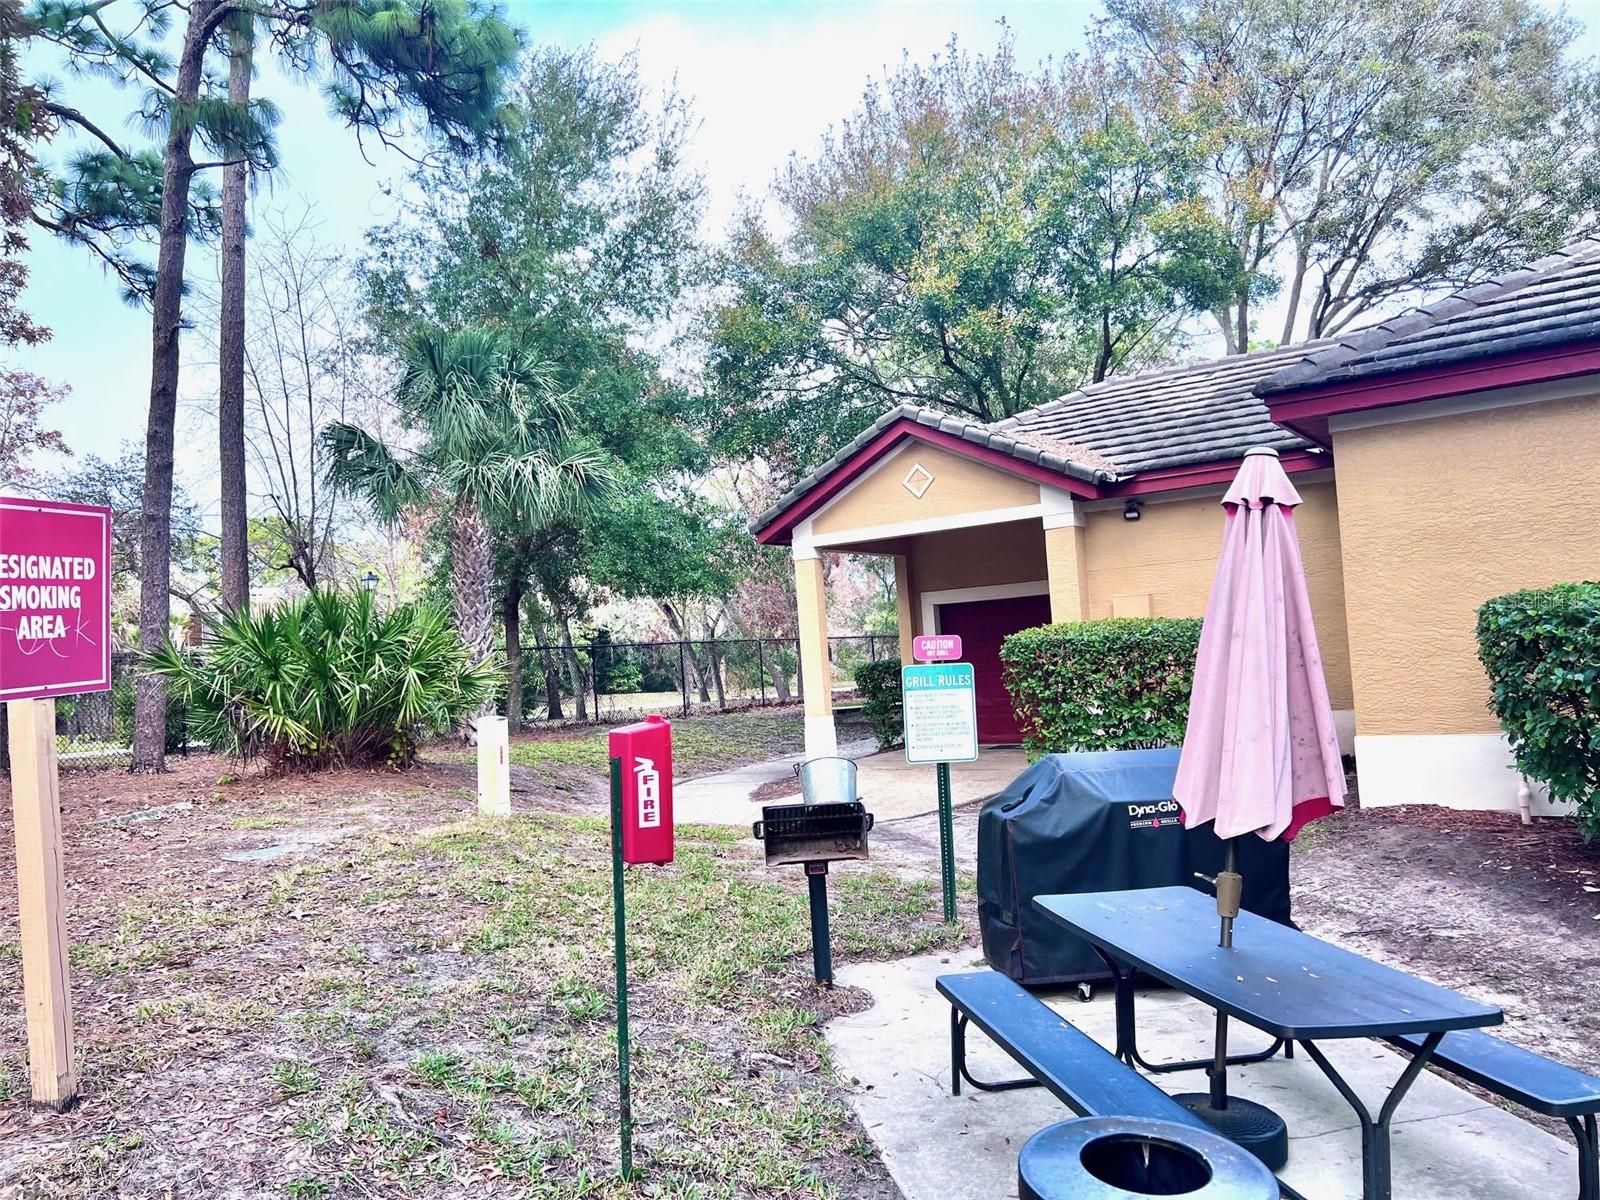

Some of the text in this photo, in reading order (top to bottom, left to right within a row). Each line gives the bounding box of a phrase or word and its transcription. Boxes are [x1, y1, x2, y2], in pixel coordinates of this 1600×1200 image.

[0, 554, 96, 580] ESIGNATED
[0, 585, 81, 610] SMOKING
[18, 615, 66, 640] AREA
[921, 640, 954, 650] CAUTION
[905, 674, 972, 688] GRILL RULES
[642, 774, 656, 823] FIRE
[1128, 801, 1178, 818] Dyna-Glo
